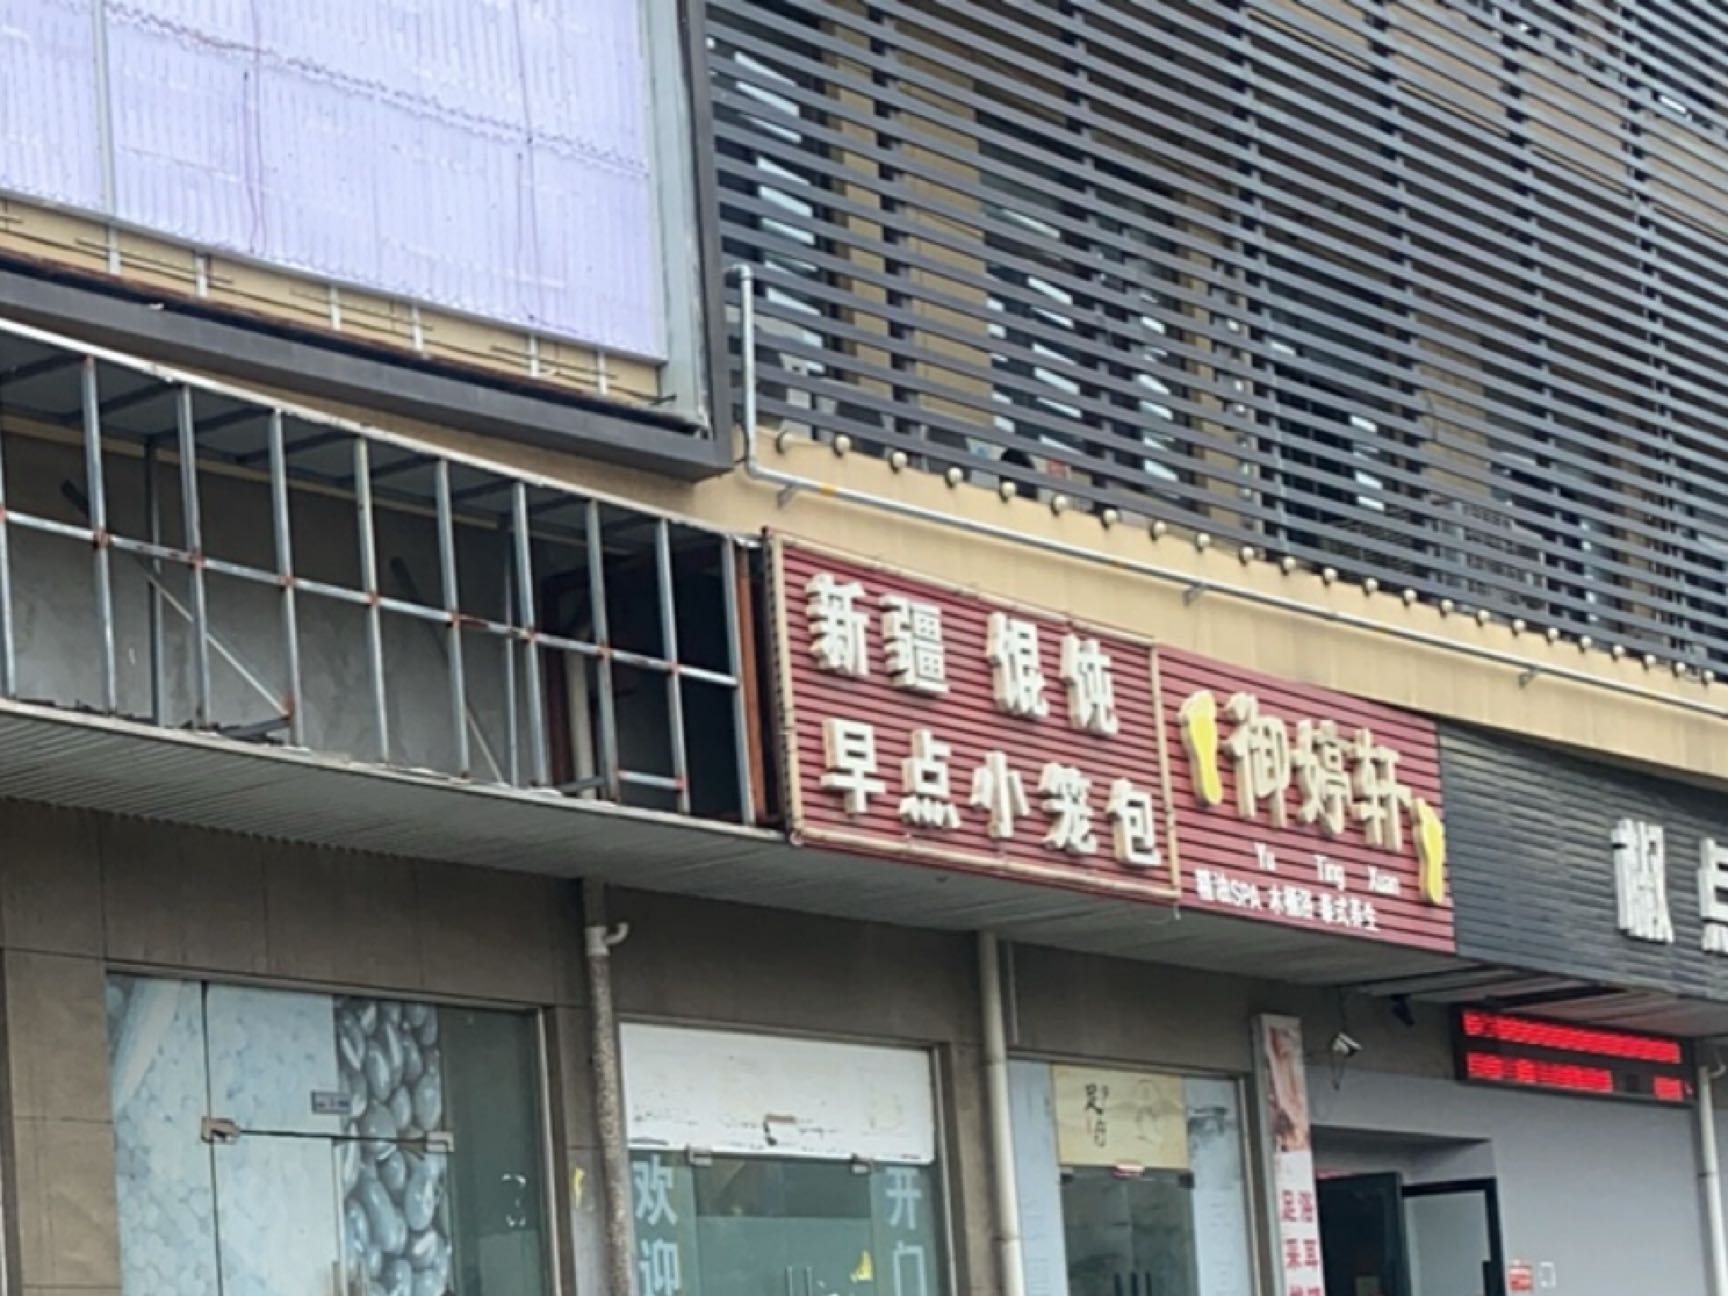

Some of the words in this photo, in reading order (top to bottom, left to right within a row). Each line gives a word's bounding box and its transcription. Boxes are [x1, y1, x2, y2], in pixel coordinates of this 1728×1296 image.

[806, 572, 949, 695] 新疆
[821, 718, 1162, 867] 早点小笼包
